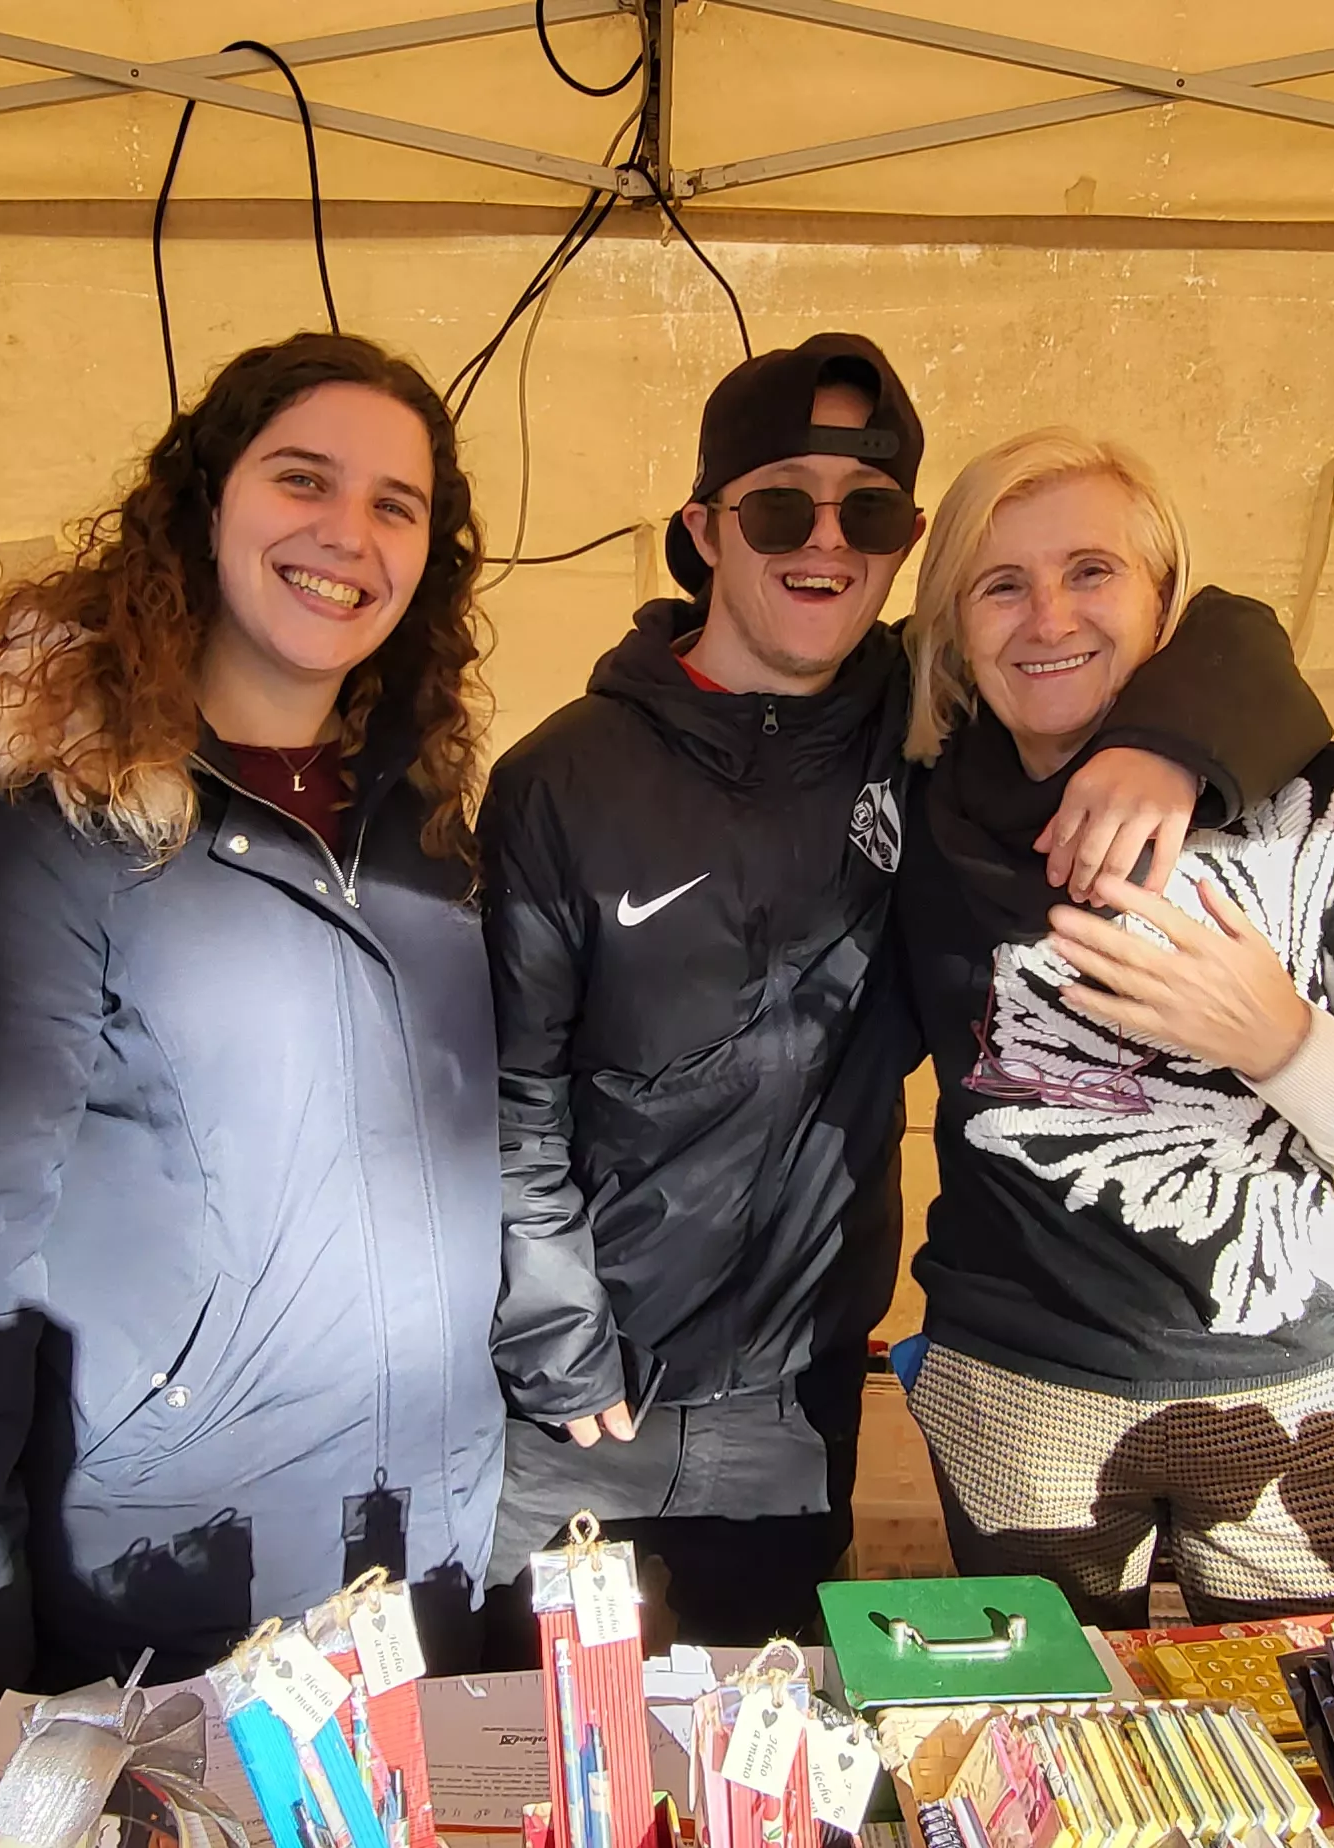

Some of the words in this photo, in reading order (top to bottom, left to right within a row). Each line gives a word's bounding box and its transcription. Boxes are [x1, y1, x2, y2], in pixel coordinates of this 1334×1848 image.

[293, 774, 306, 792] L
[376, 1650, 392, 1686] mano
[387, 1633, 404, 1673] Hecho
[1207, 1661, 1221, 1673] 3
[1241, 1658, 1256, 1670] 2
[285, 1684, 294, 1693] a
[294, 1693, 324, 1725] mano
[300, 1672, 333, 1708] Hecho
[742, 1741, 759, 1780] mano
[760, 1734, 778, 1777] Hecho
[809, 1763, 832, 1804] Hecho
